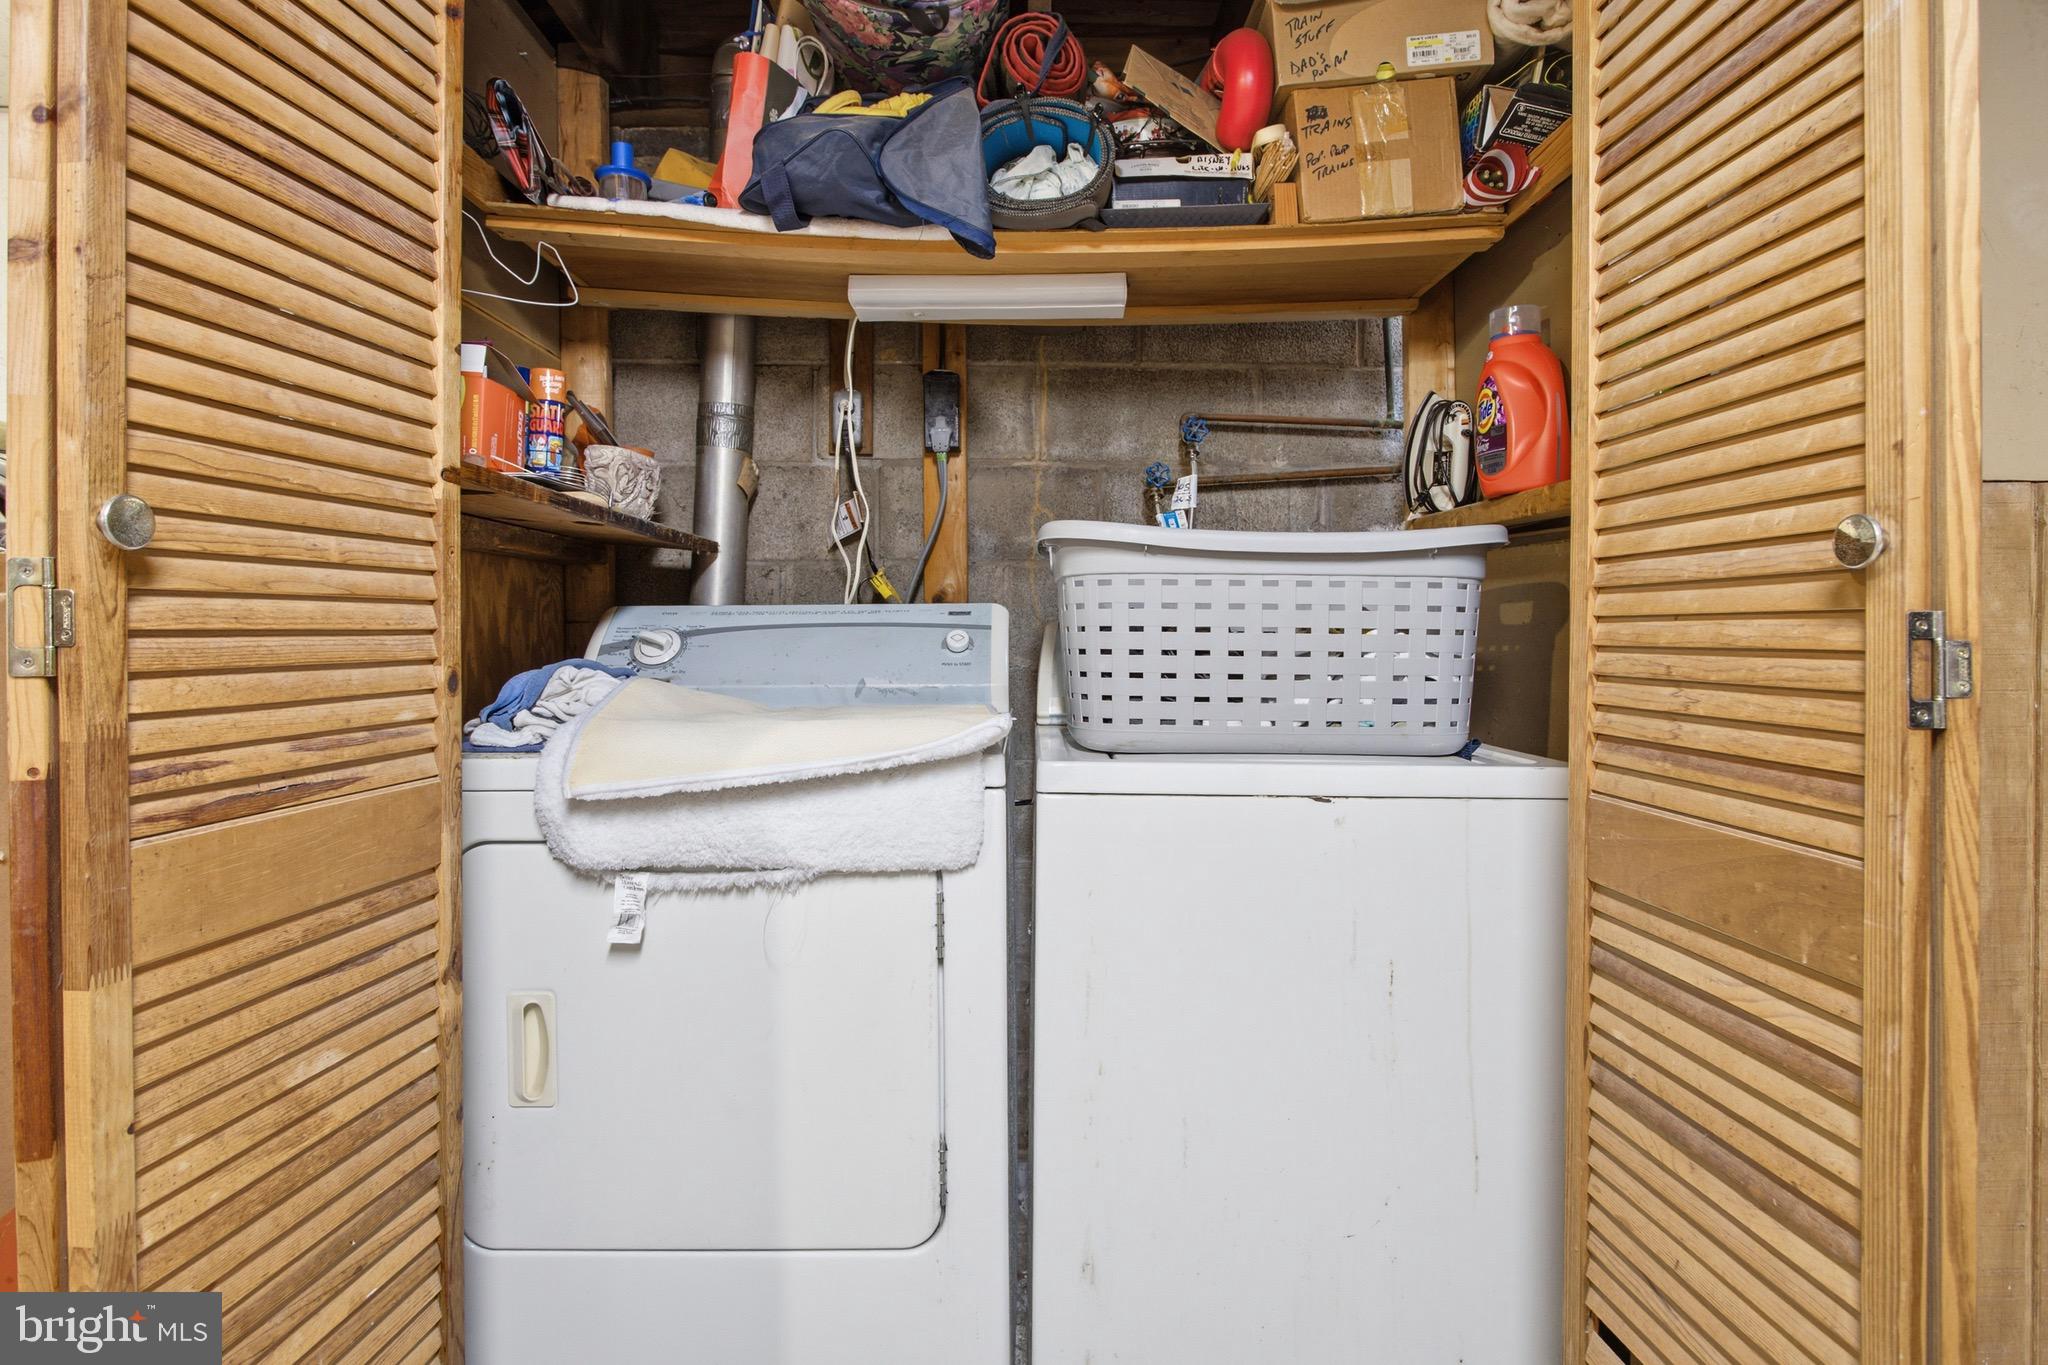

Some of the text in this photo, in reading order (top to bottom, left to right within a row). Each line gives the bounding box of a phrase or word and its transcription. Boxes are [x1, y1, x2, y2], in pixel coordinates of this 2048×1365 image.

[1285, 10, 1323, 39] TRAIN
[1295, 18, 1336, 49] STUFF
[1290, 51, 1326, 75] DAD'S
[1301, 117, 1352, 139] TRAINS
[1197, 156, 1231, 165] DISNEY
[1312, 158, 1354, 181] TRAINS
